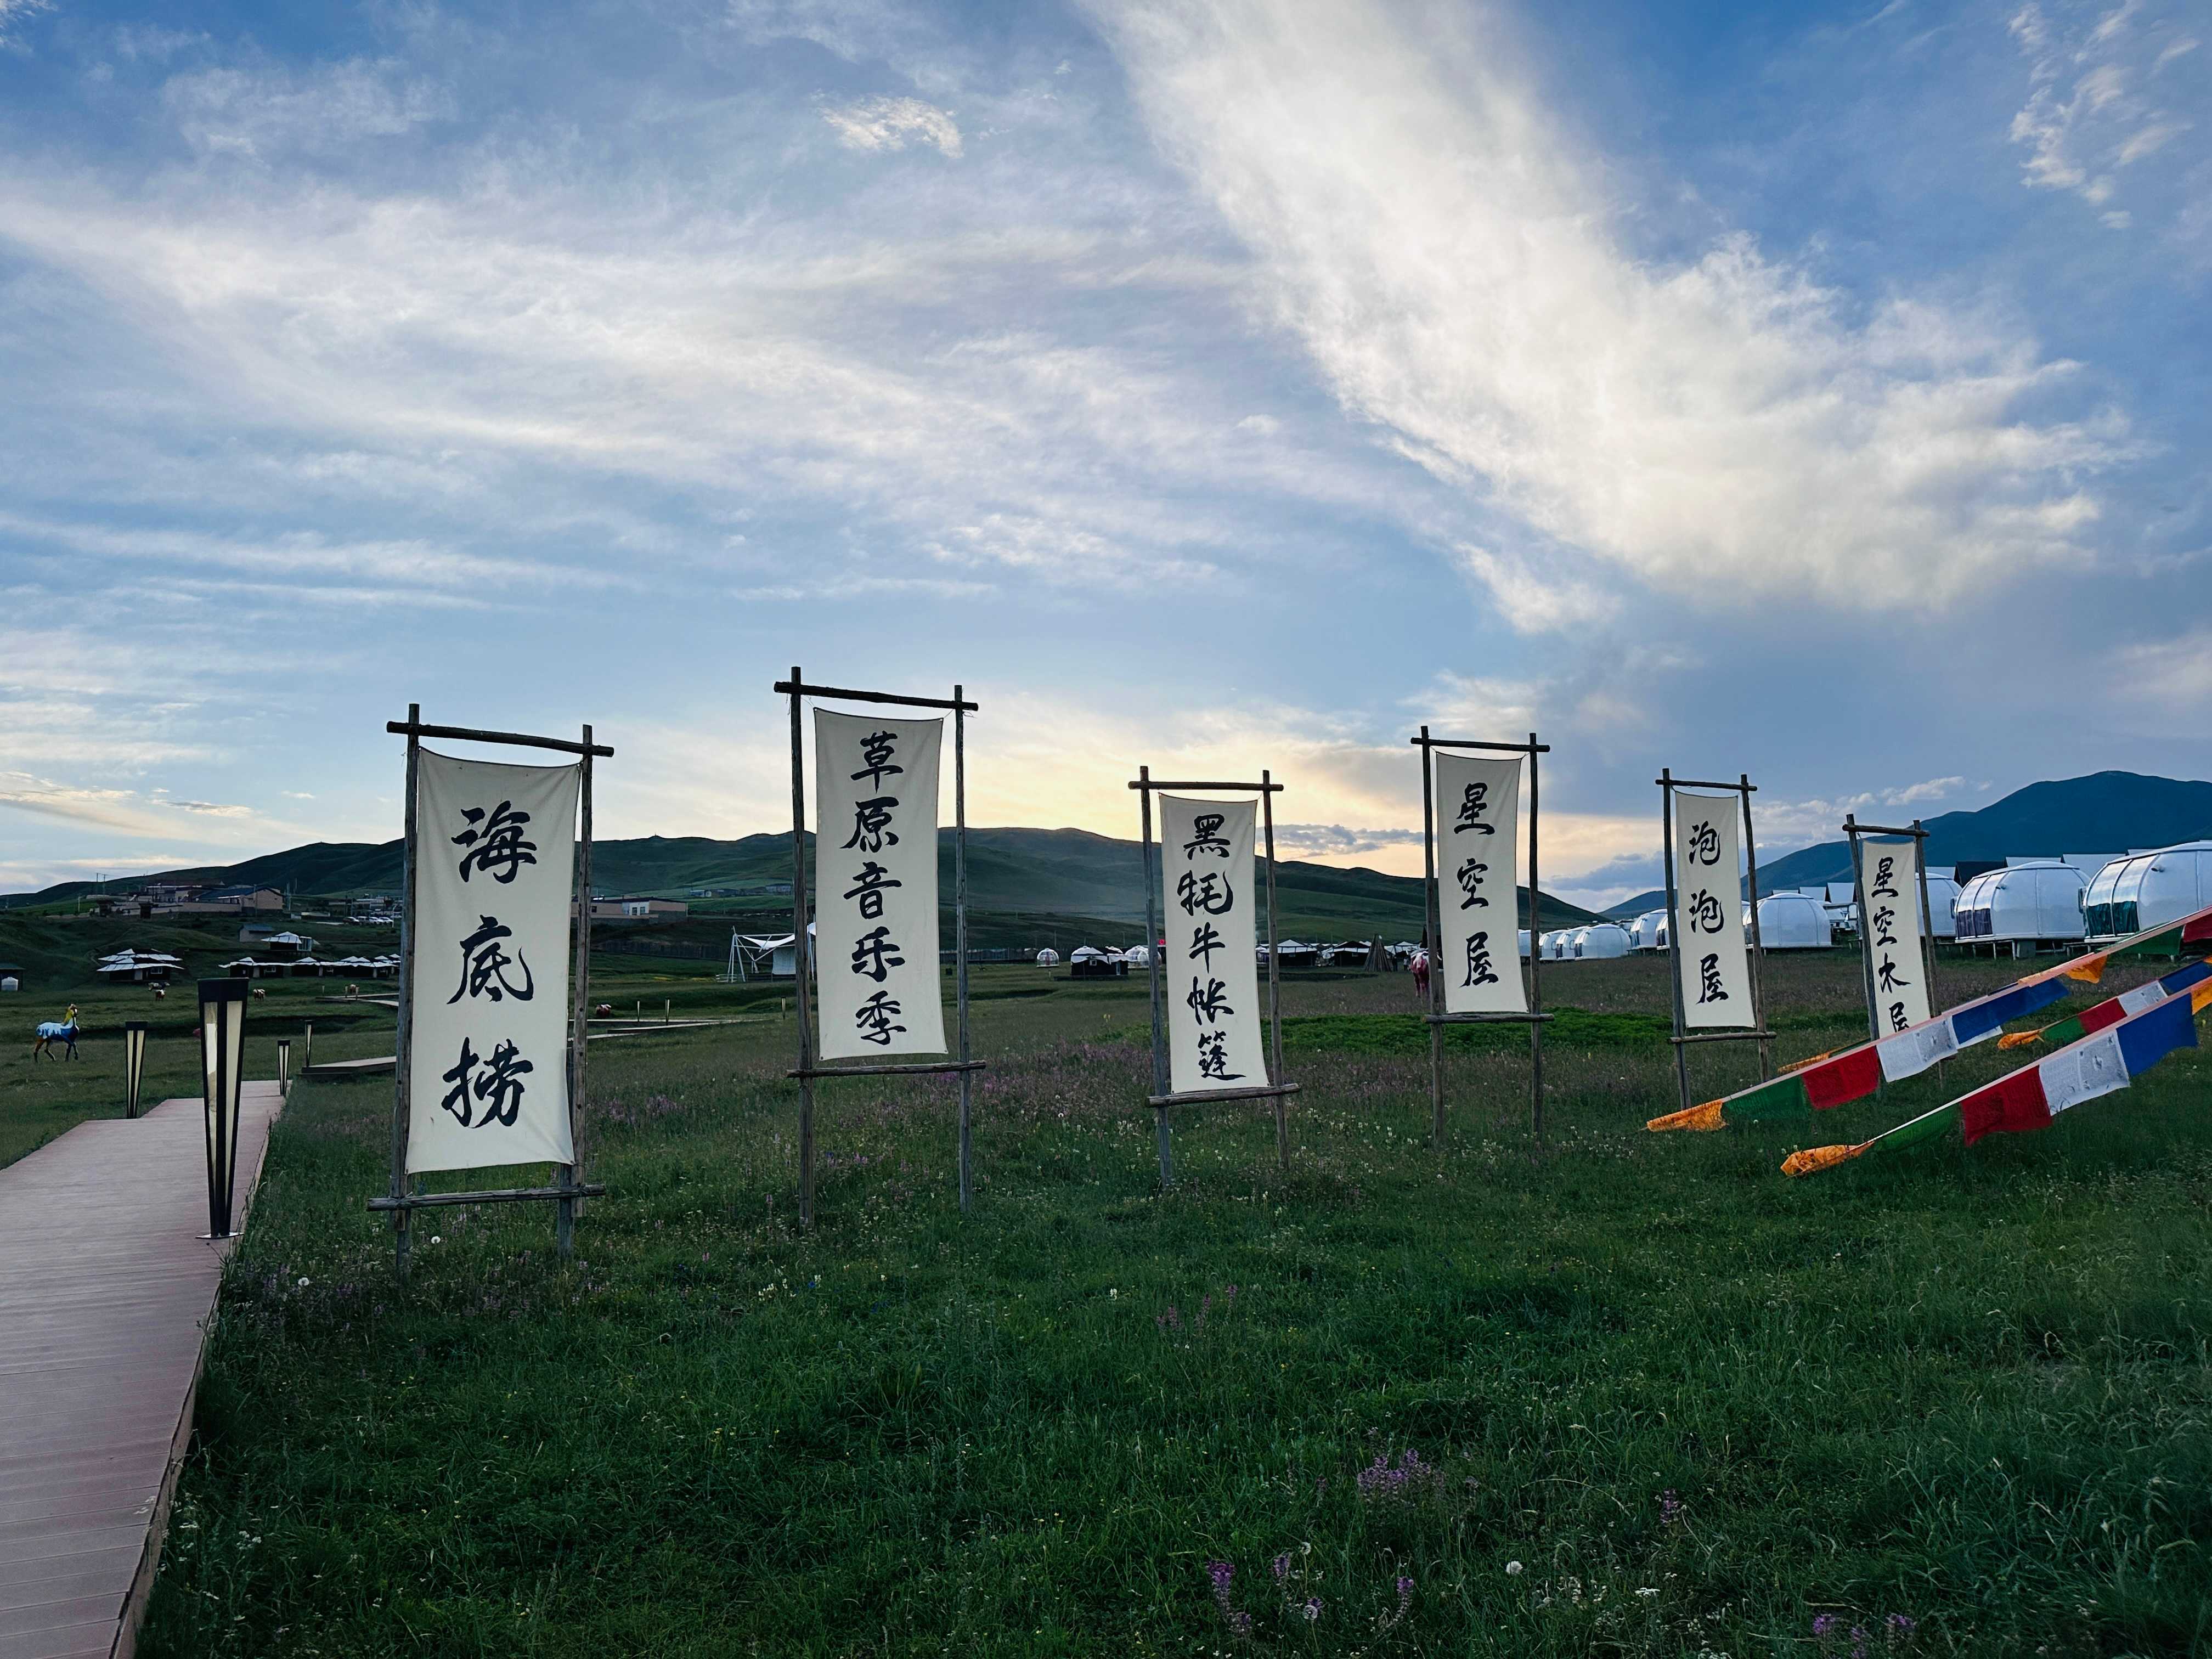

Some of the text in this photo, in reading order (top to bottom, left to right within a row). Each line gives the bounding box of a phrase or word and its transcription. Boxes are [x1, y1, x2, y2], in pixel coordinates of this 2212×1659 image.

[441, 800, 537, 1128] 海底捞
[840, 730, 907, 1045] 草原音乐季
[1454, 782, 1498, 988] 星空屋
[1689, 821, 1728, 1005] 泡泡屋
